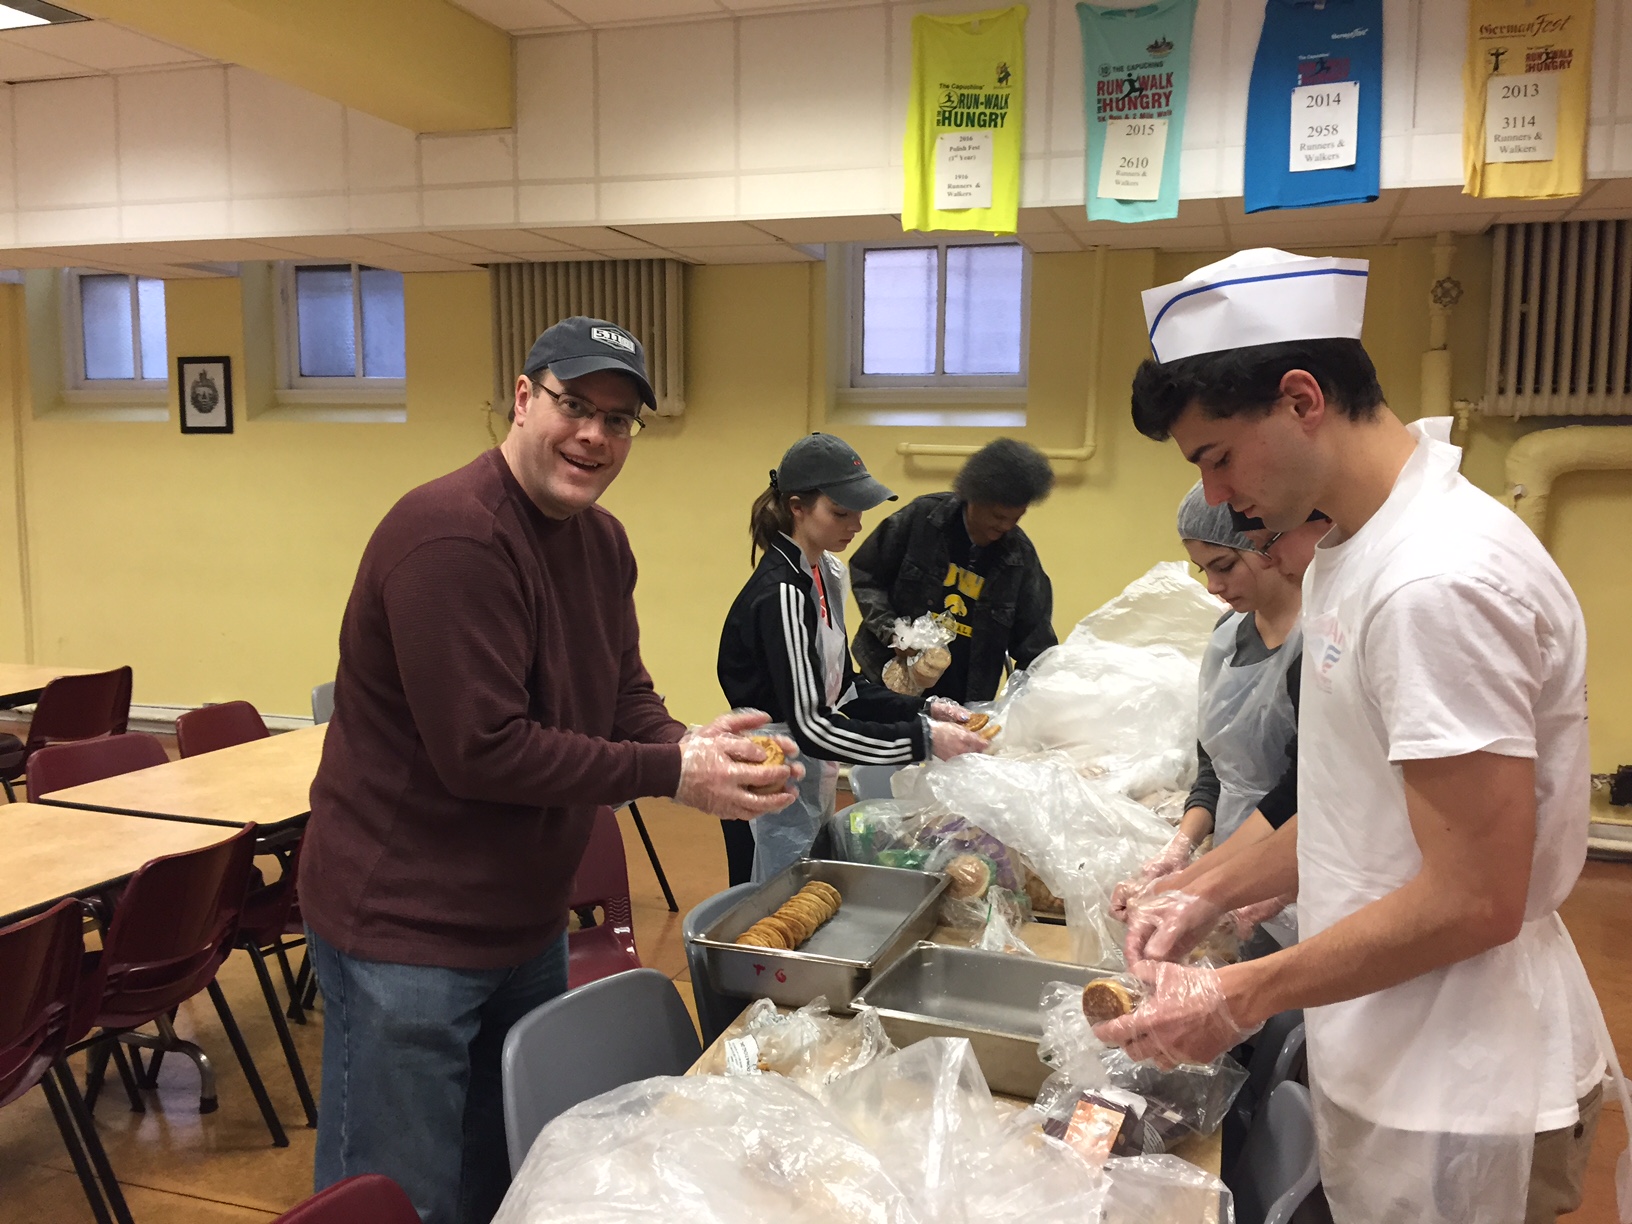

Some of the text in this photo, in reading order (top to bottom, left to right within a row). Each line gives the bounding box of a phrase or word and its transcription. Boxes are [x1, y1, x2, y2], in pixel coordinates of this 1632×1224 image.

[1528, 59, 1572, 72] HUNGRY
[1097, 72, 1174, 96] RUN WALK
[1502, 83, 1539, 99] 2013
[1102, 90, 1172, 113] HUNGRY
[1306, 92, 1341, 108] 2014
[941, 110, 1007, 128] HUNGRY
[1502, 115, 1536, 129] 3114
[1126, 124, 1155, 136] 2015
[1307, 124, 1339, 138] 2958
[1494, 131, 1542, 142] Runners &
[1300, 139, 1345, 151] Runners &
[1500, 145, 1537, 153] Walkers
[1120, 156, 1149, 168] 2610
[1305, 153, 1340, 162] Walkers
